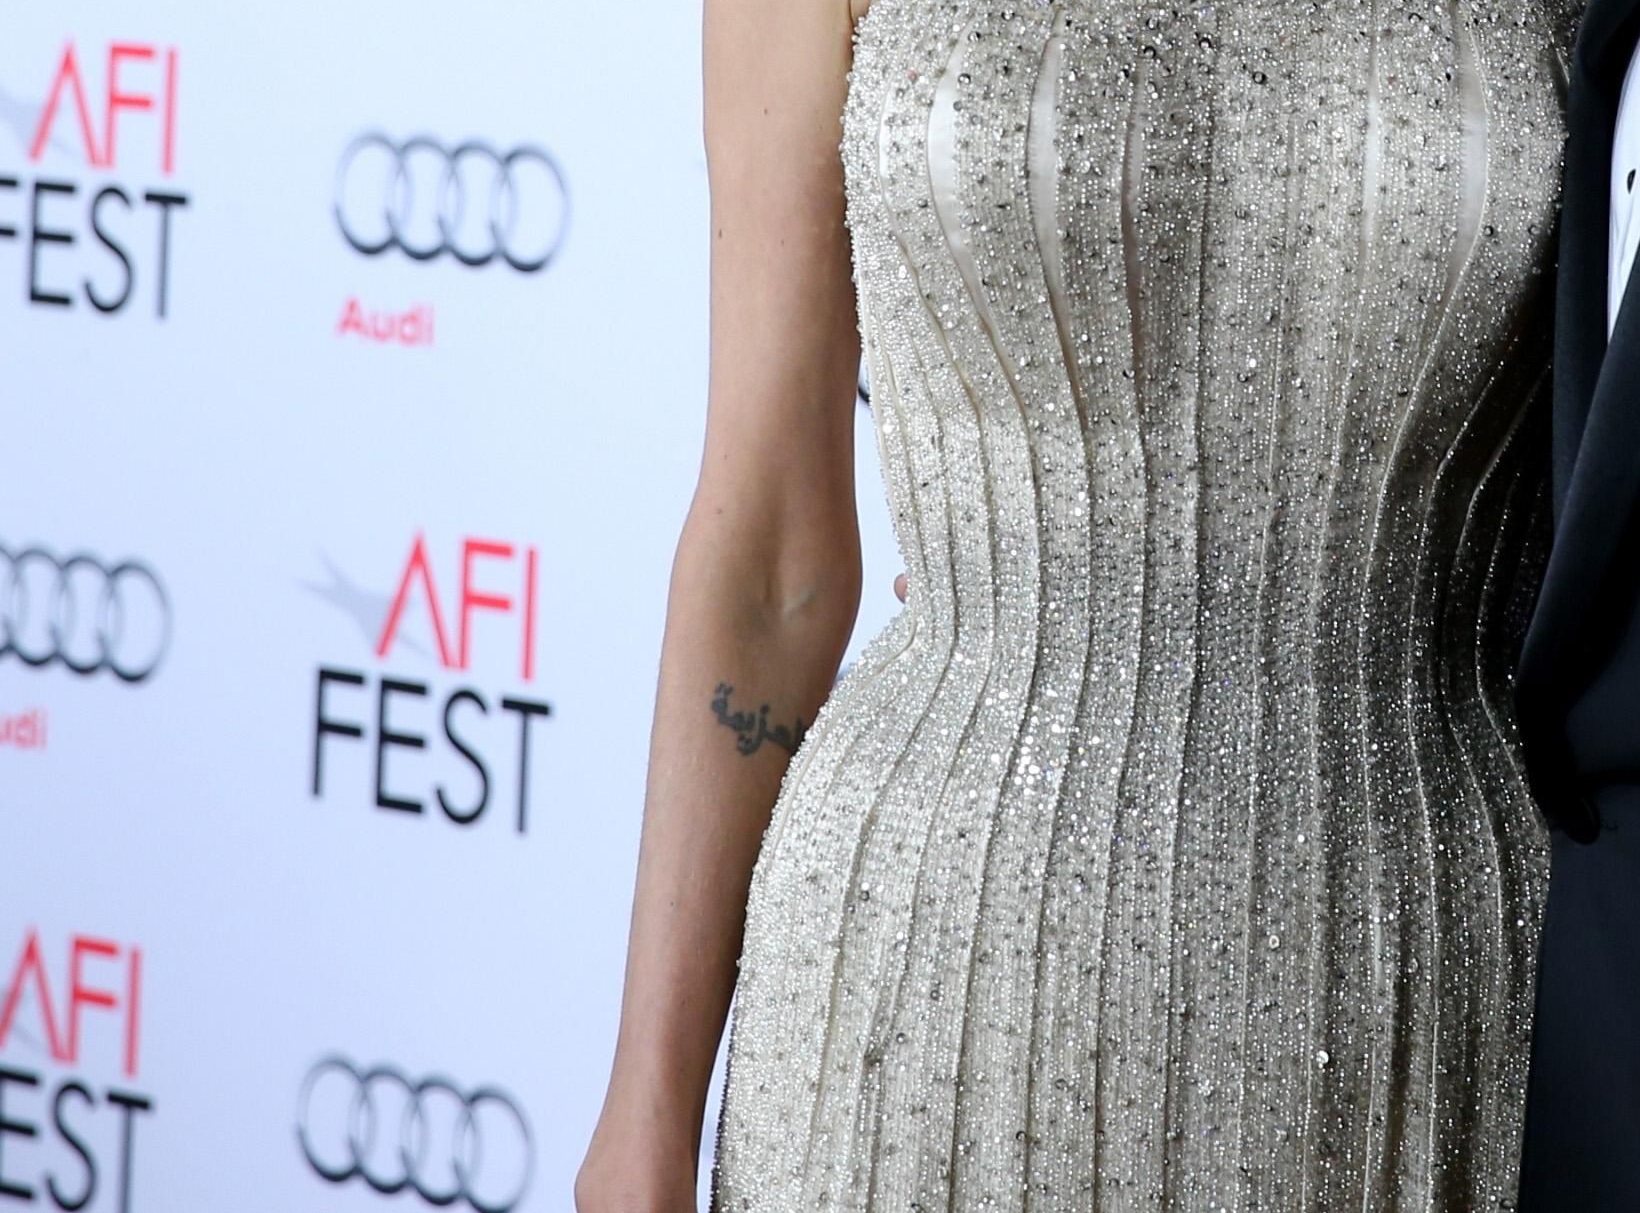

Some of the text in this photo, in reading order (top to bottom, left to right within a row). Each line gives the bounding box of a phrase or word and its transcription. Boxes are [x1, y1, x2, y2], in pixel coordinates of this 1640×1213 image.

[30, 41, 178, 174] AFI
[336, 298, 434, 347] Audi
[375, 534, 539, 682] AFI
[0, 708, 47, 750] udi
[311, 666, 553, 835] FEST
[0, 929, 142, 1077] AFI
[0, 1066, 153, 1213] EST
